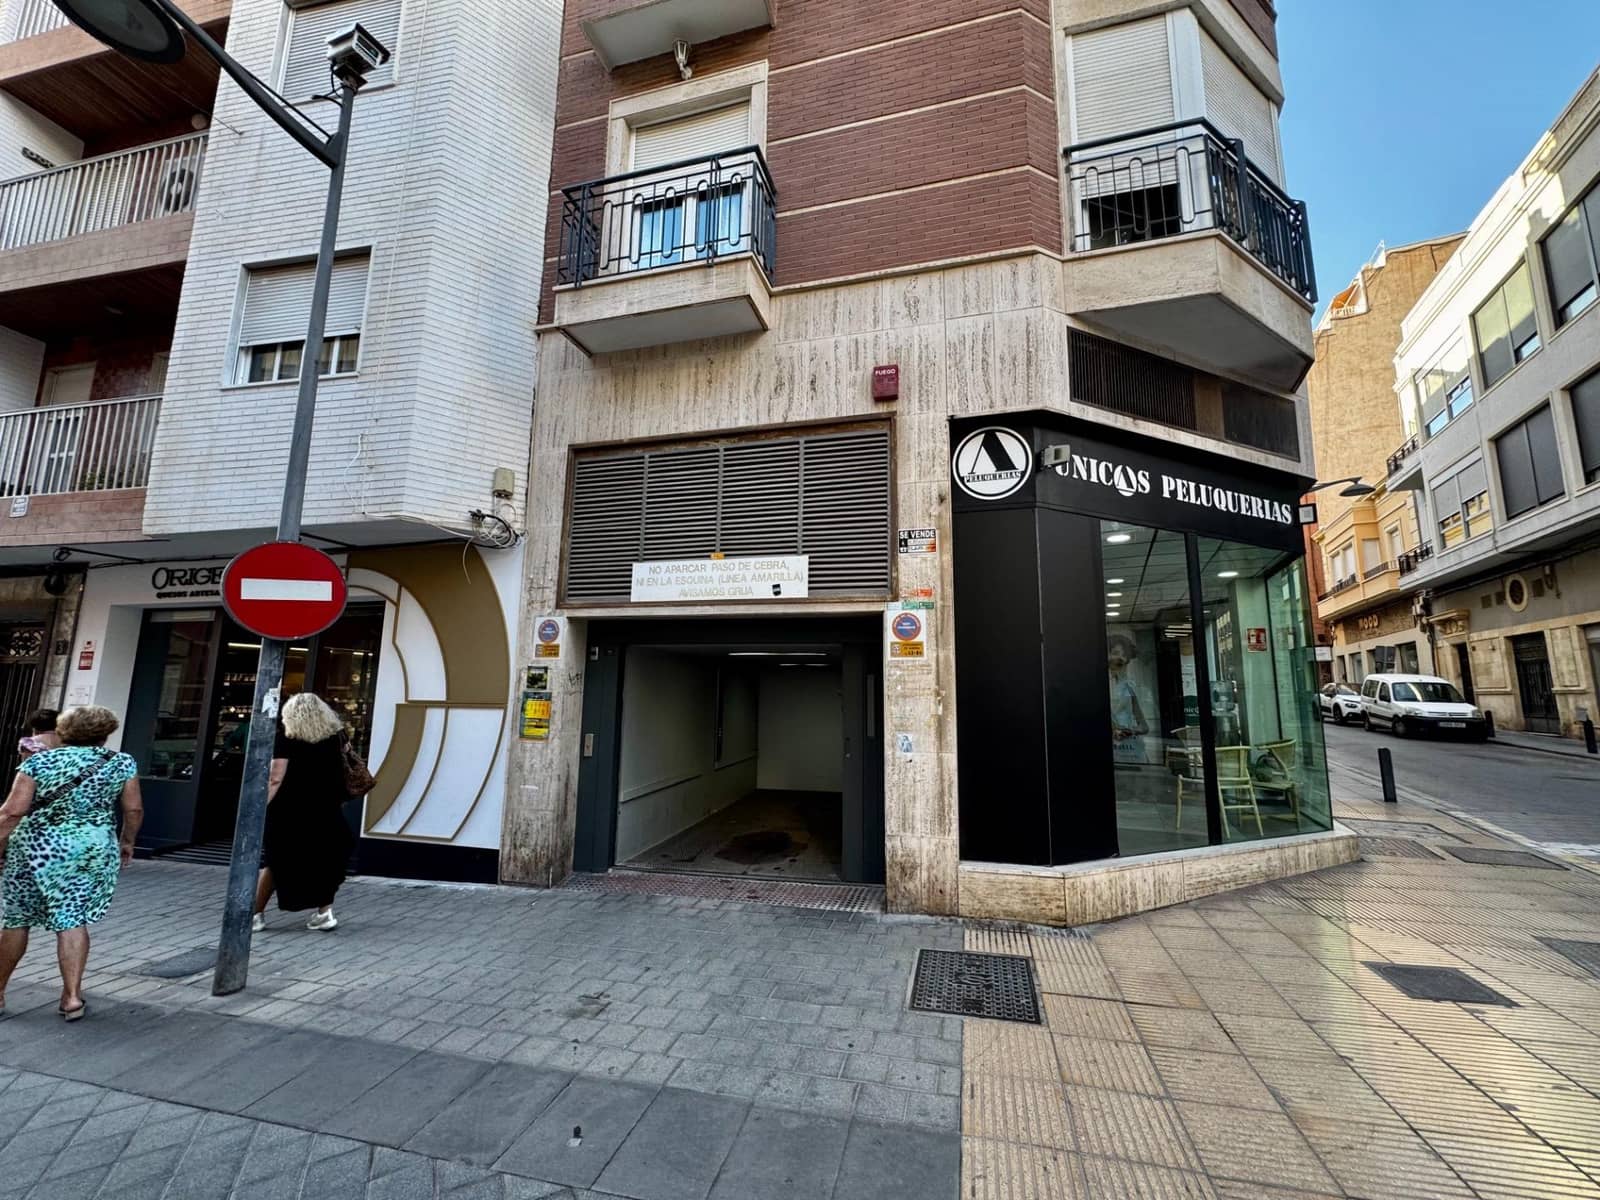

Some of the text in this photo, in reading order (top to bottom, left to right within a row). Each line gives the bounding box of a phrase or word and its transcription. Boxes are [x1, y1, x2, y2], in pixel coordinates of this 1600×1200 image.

[875, 368, 896, 376] FUEGO
[1161, 474, 1293, 525] PELUQUERIAS
[900, 530, 935, 540] SE VENDE
[649, 560, 789, 575] NO APARCAR PASO DE CEBRA,
[152, 567, 224, 590] ORIGE
[647, 577, 659, 586] EN
[660, 576, 672, 585] LA
[675, 574, 714, 585] ESQUINA
